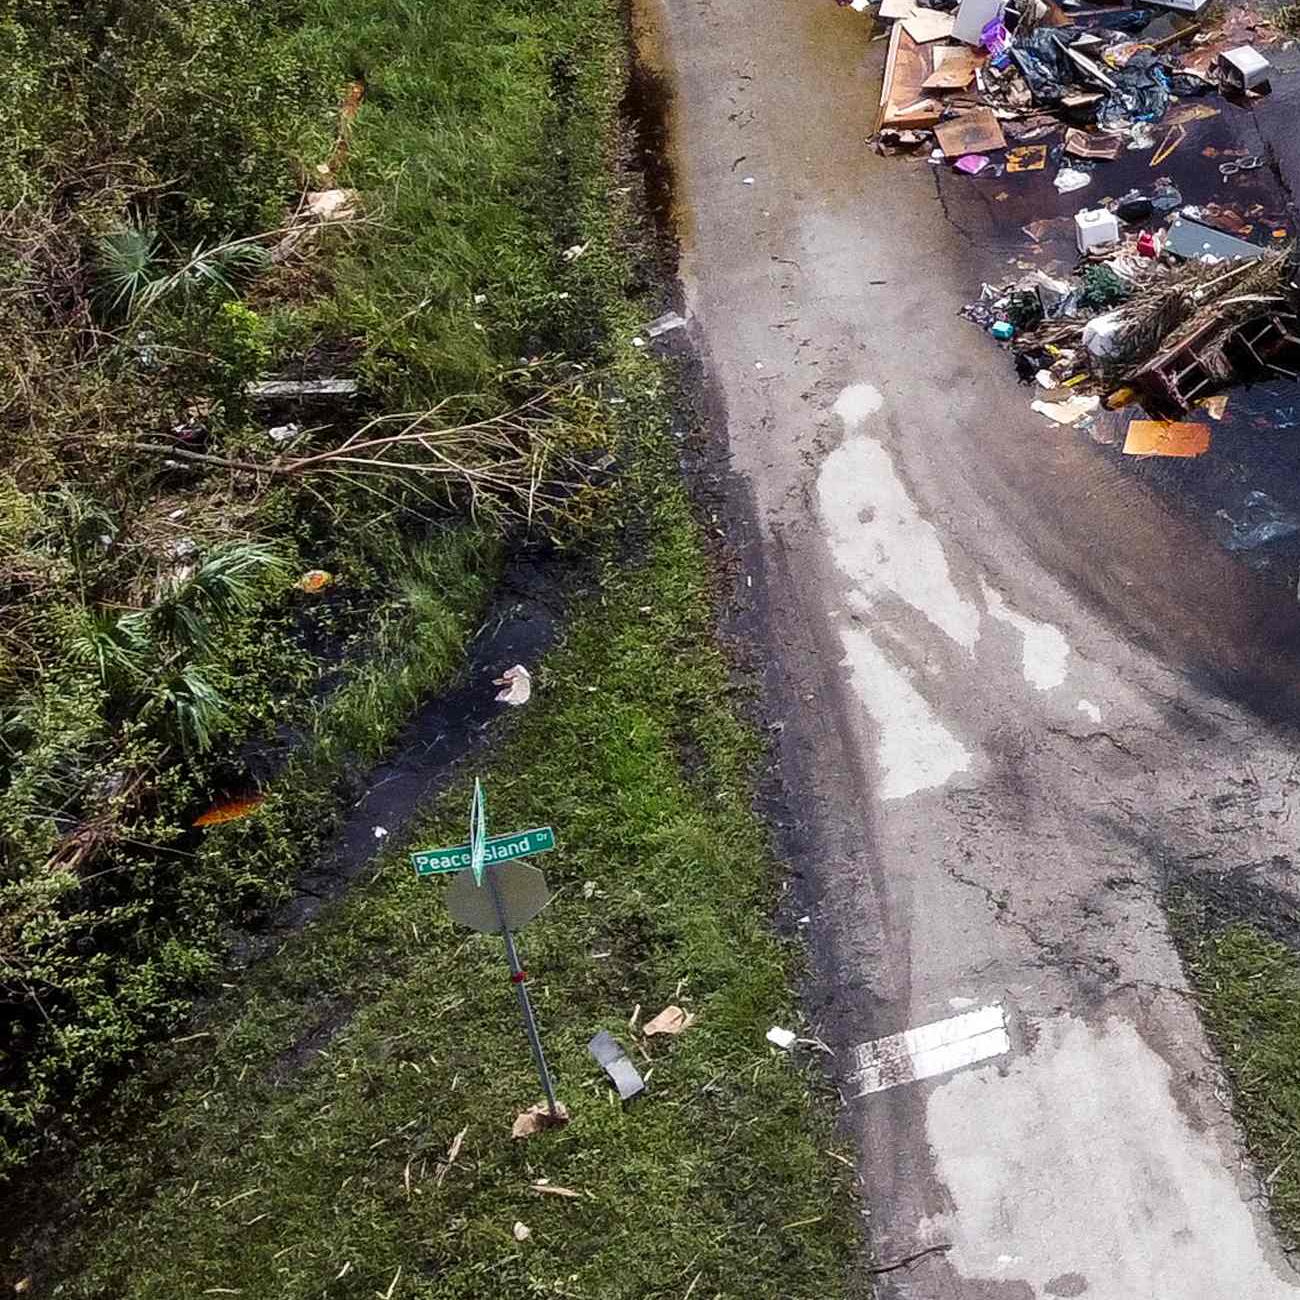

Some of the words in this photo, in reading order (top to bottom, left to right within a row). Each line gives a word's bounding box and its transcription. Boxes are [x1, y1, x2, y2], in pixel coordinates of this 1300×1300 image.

[416, 853, 471, 871] Peace
[483, 836, 530, 861] sland
[535, 832, 548, 842] Dr
